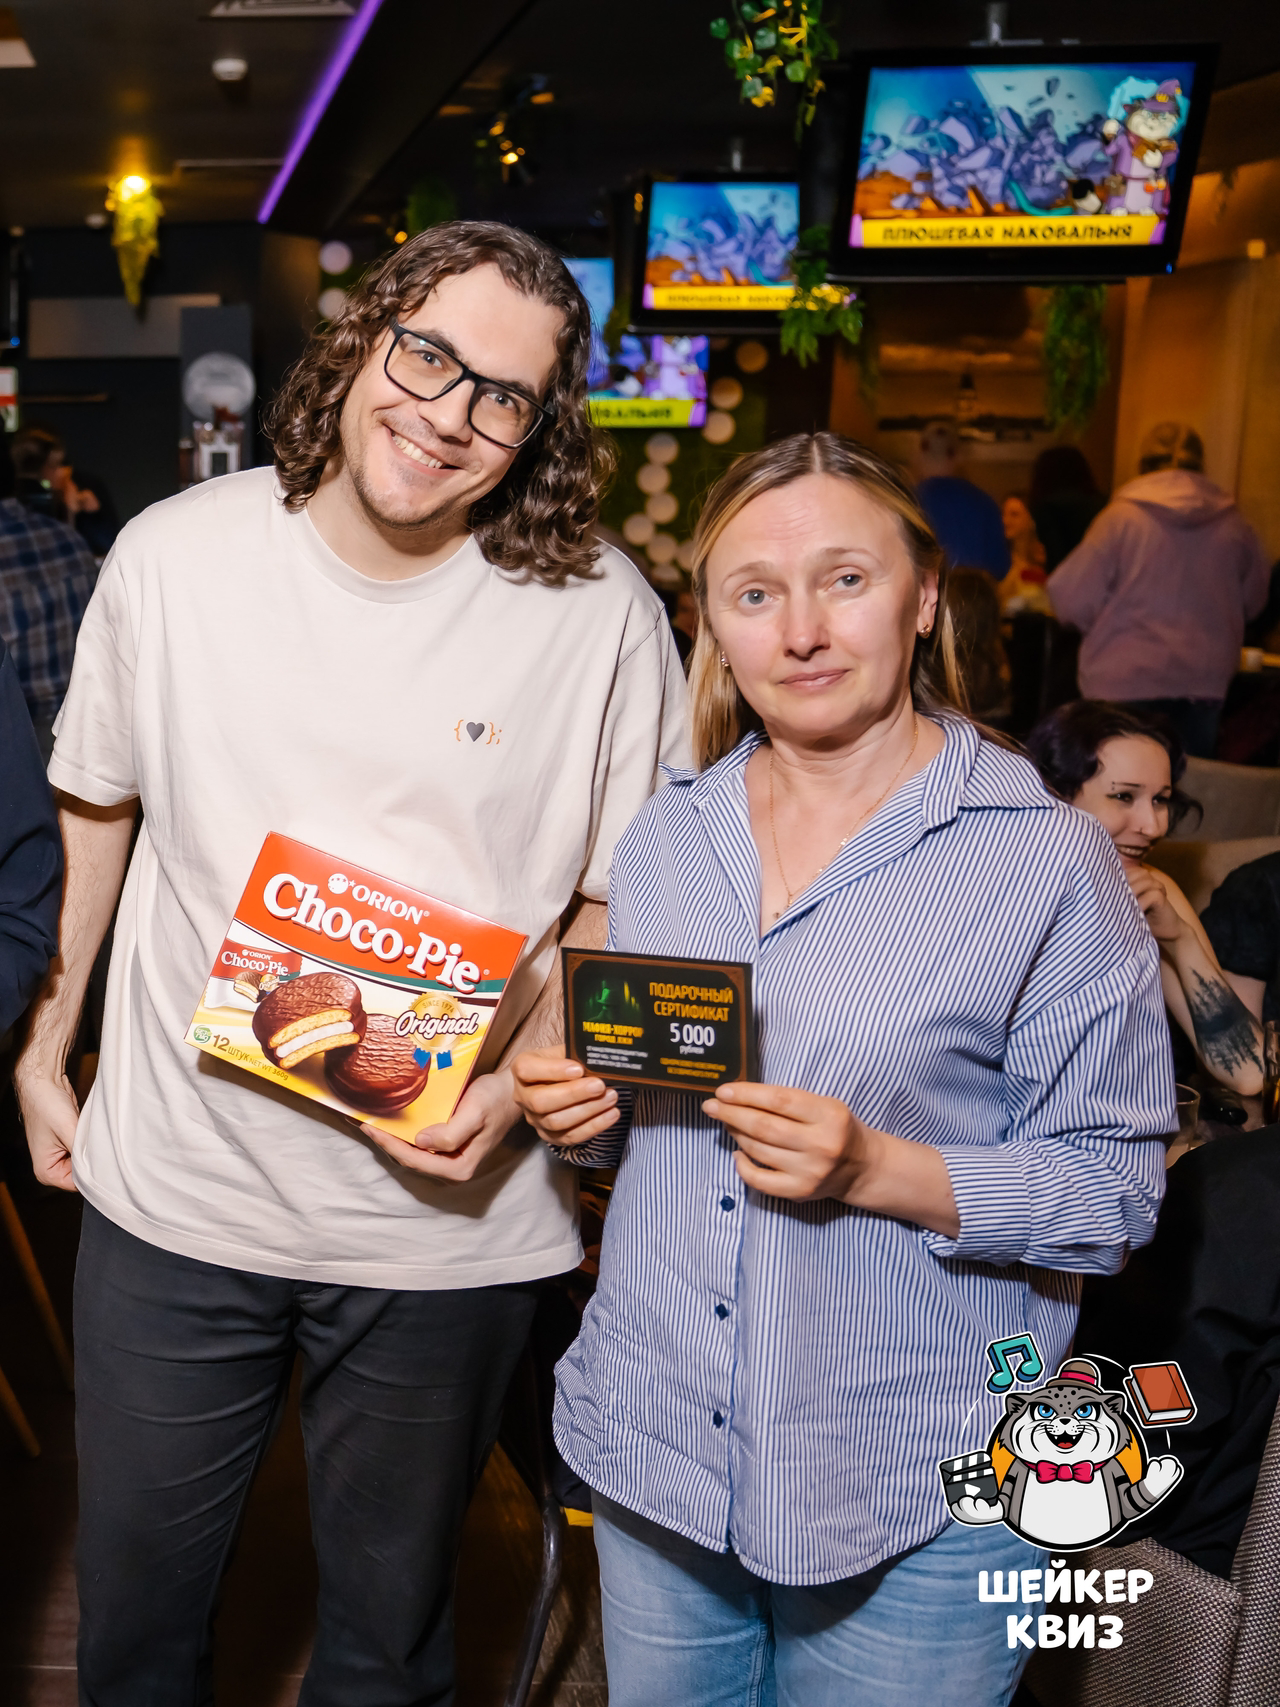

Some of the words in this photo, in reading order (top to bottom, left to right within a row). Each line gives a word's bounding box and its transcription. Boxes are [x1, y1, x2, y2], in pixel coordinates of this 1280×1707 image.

[882, 226, 994, 242] ПЛЮШЕВАЯ
[1001, 224, 1133, 241] НАКОВАЛЬНЯ
[351, 884, 425, 925] ORION
[649, 981, 734, 1004] ПОДАРОЧНЫЙ
[422, 1000, 440, 1009] SINCE
[441, 1001, 455, 1014] 1974
[653, 1001, 730, 1022] СЕРТИФИКАТ
[395, 1010, 480, 1040] Original
[213, 1034, 230, 1052] 12
[249, 1058, 262, 1068] NET
[272, 1068, 289, 1081] 360g
